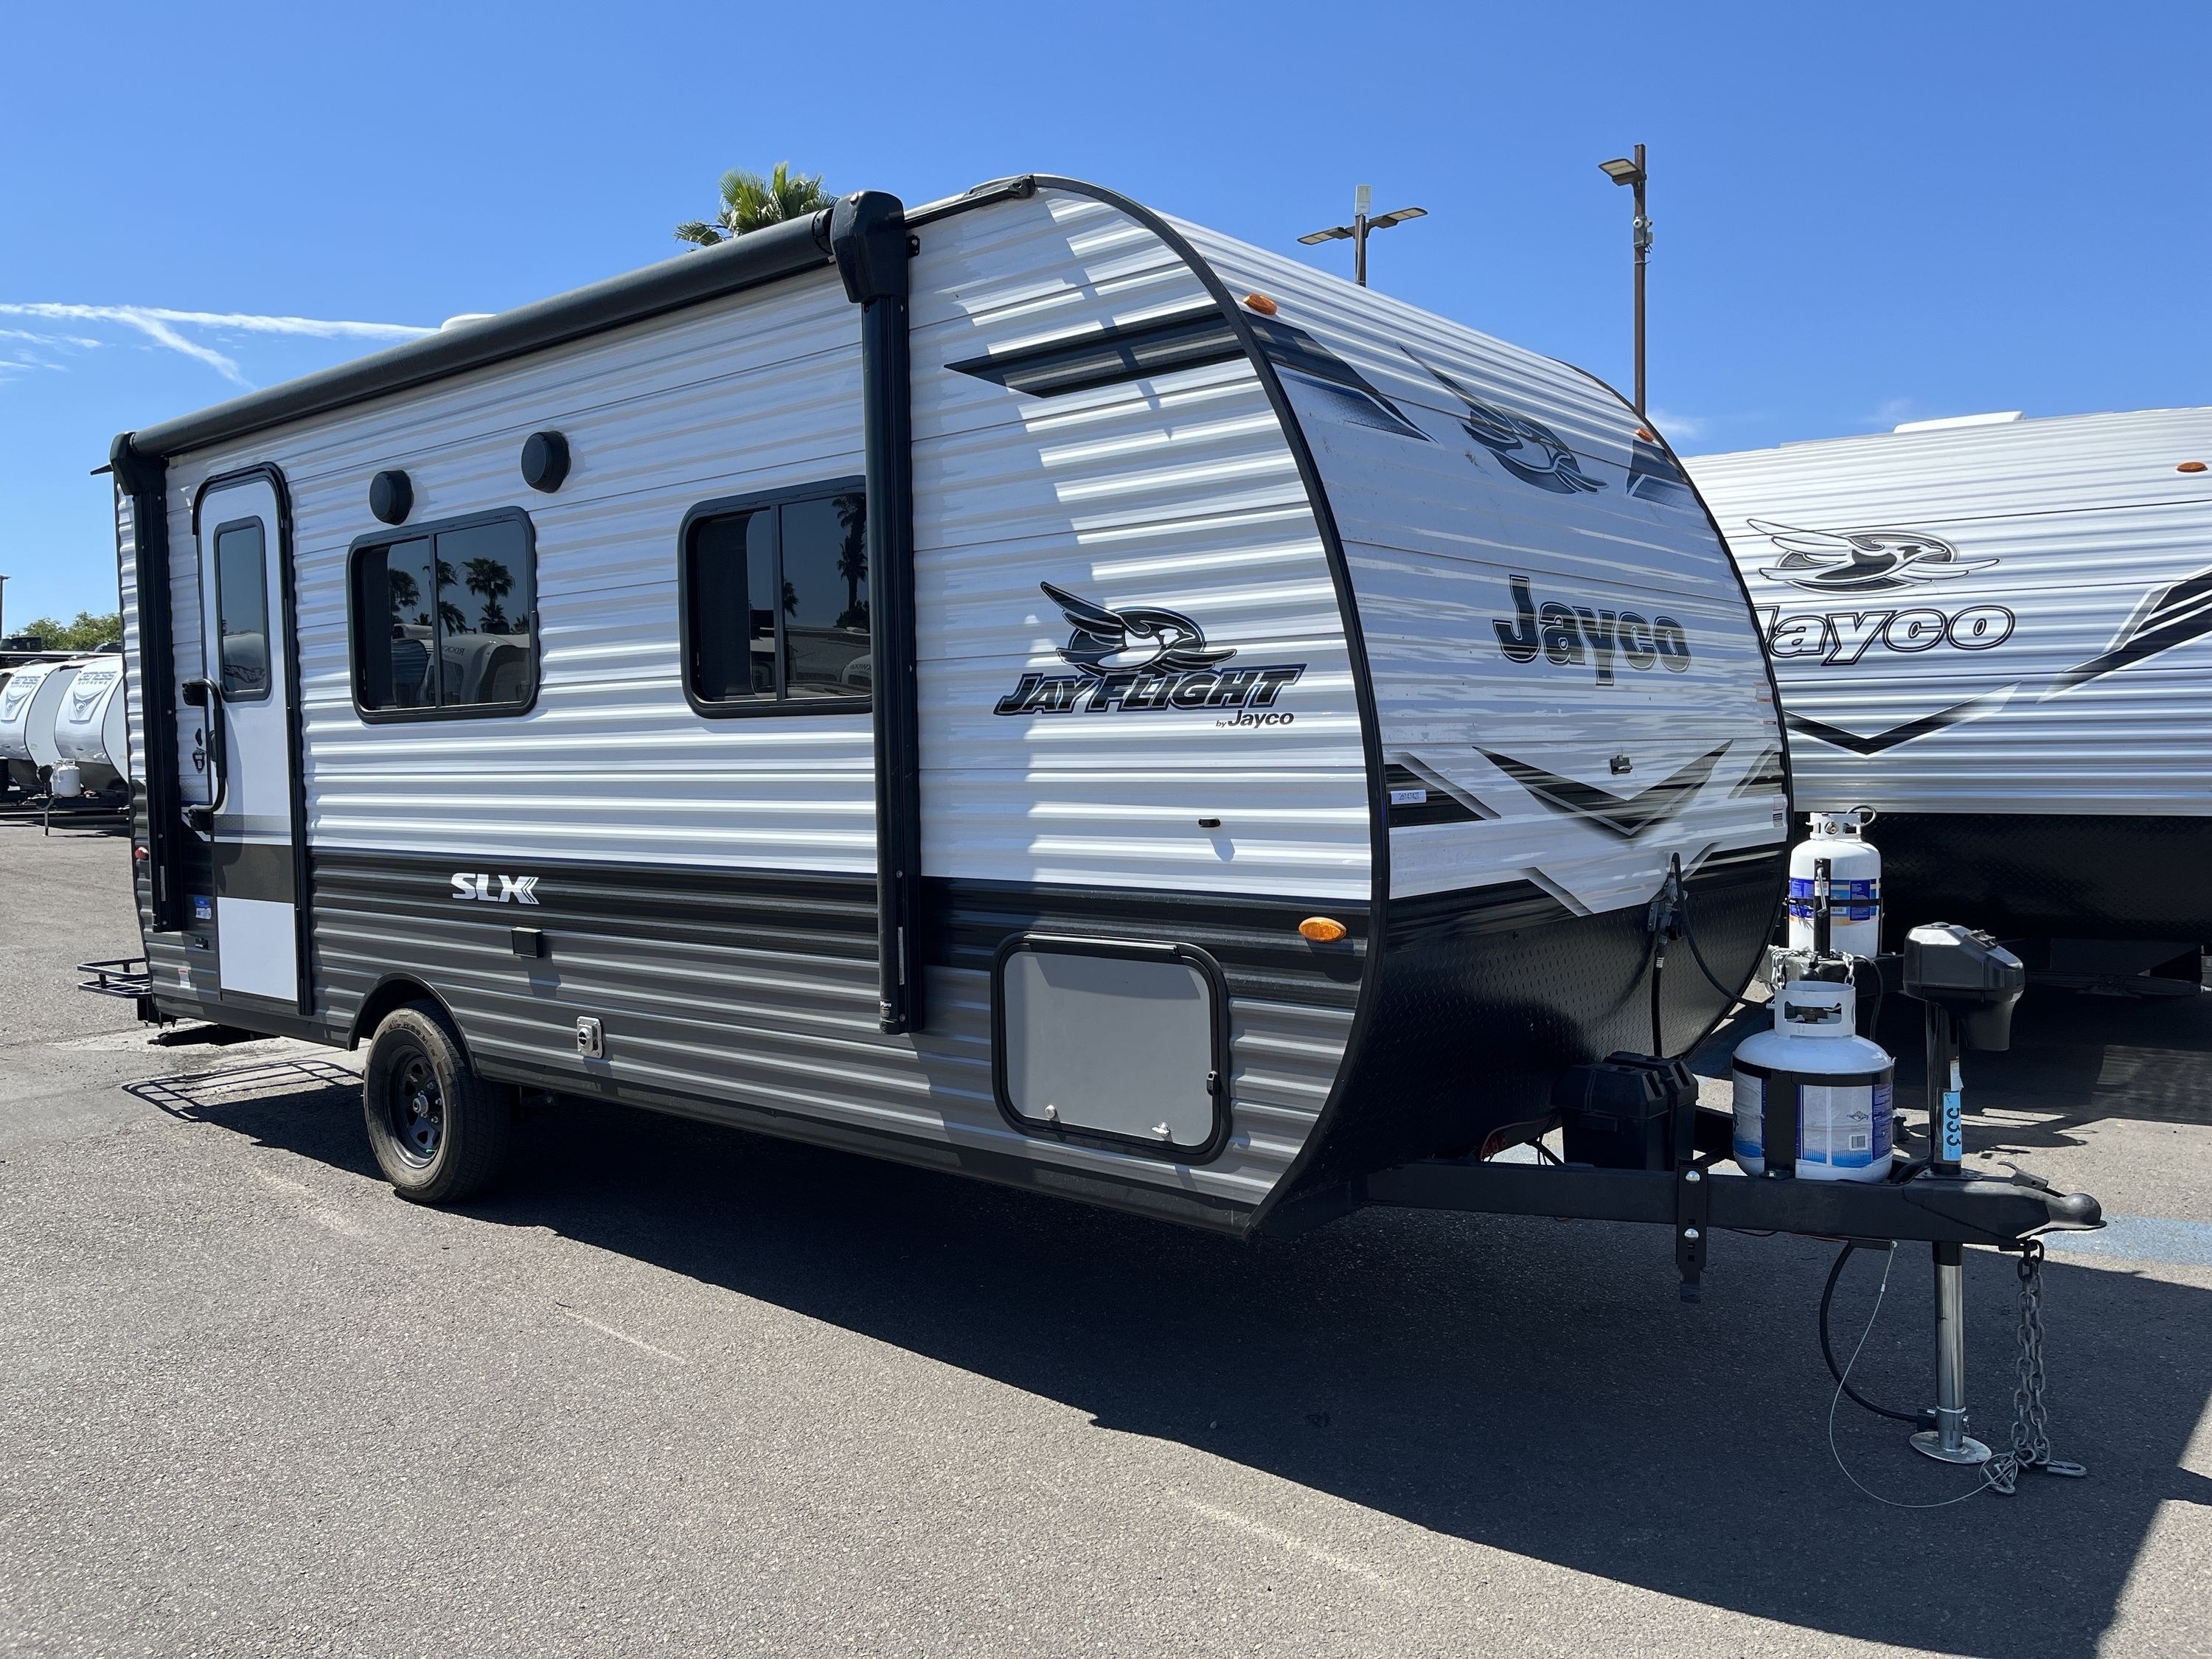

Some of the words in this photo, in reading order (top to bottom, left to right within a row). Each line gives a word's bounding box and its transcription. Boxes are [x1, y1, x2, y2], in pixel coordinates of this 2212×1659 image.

[1492, 574, 1691, 686] Jayco
[1215, 720, 1227, 728] by
[1227, 709, 1294, 728] Jayco
[451, 872, 540, 905] SLX
